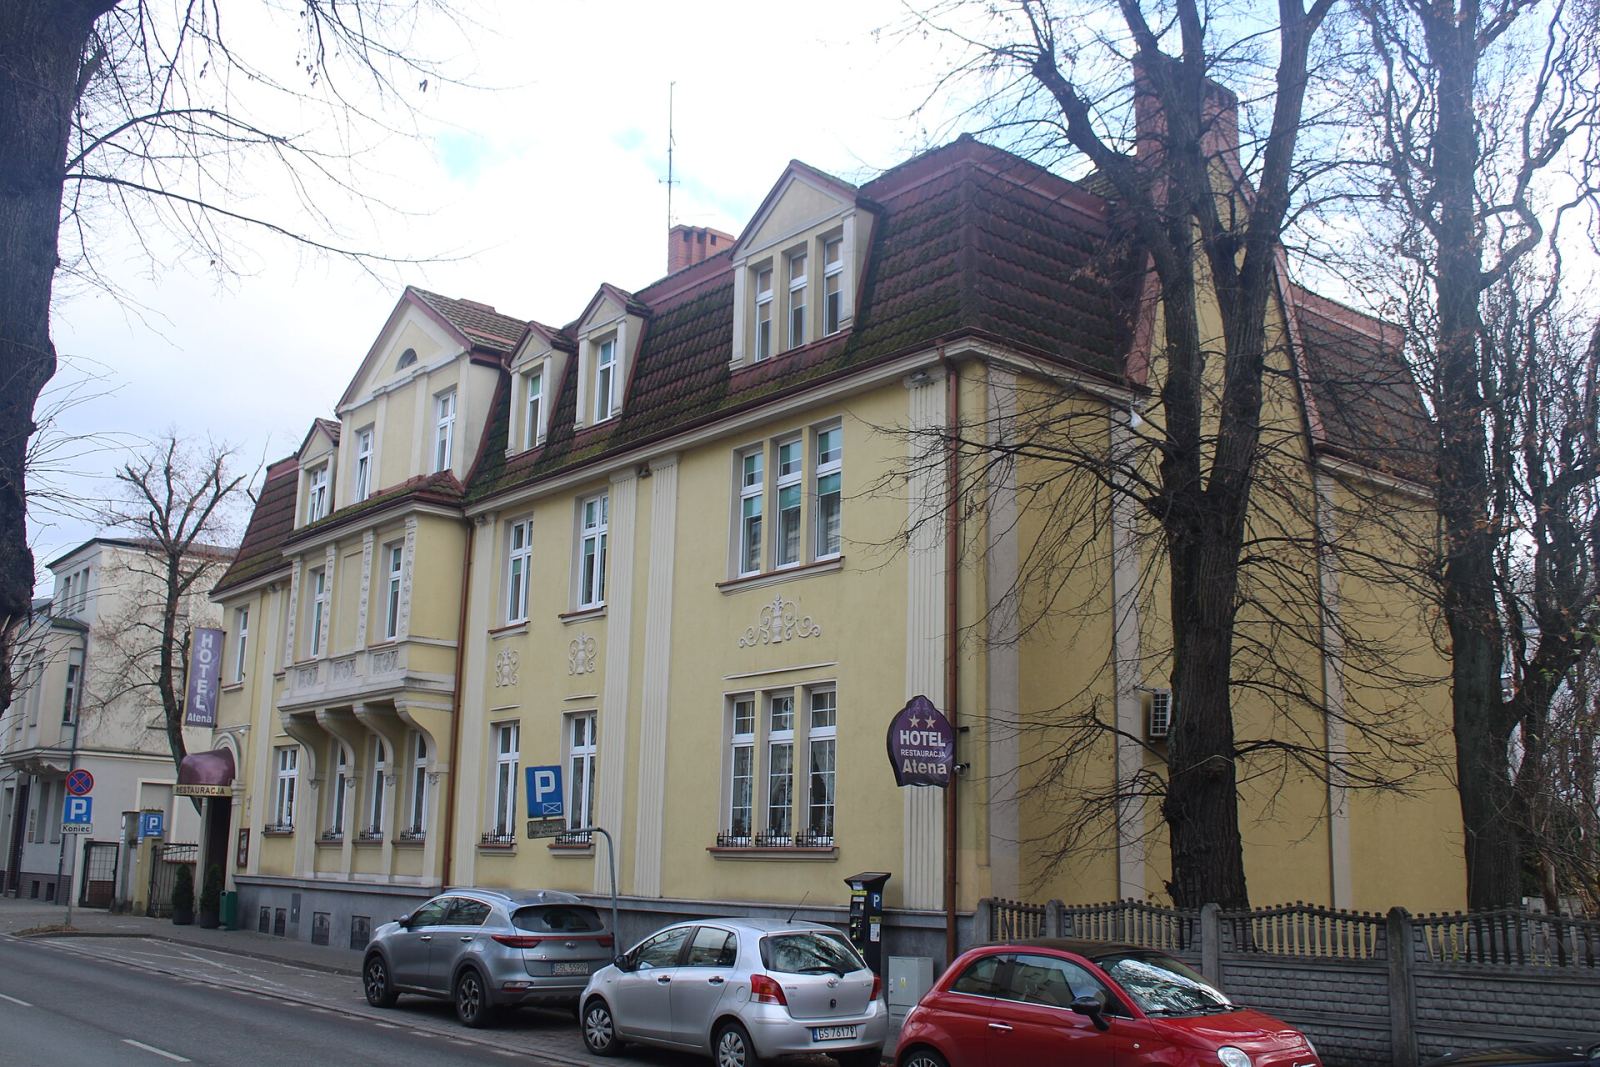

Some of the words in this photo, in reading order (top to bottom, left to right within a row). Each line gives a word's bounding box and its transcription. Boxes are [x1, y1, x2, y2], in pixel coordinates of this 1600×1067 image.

[195, 633, 213, 710] HOTEL
[187, 712, 212, 723] Atena
[900, 730, 946, 747] HOTEL
[900, 749, 946, 758] RESTAURACJA
[903, 759, 947, 775] Atena
[534, 770, 556, 803] P
[70, 799, 87, 820] P
[149, 817, 159, 829] P
[873, 894, 880, 908] P
[819, 1027, 830, 1039] GS
